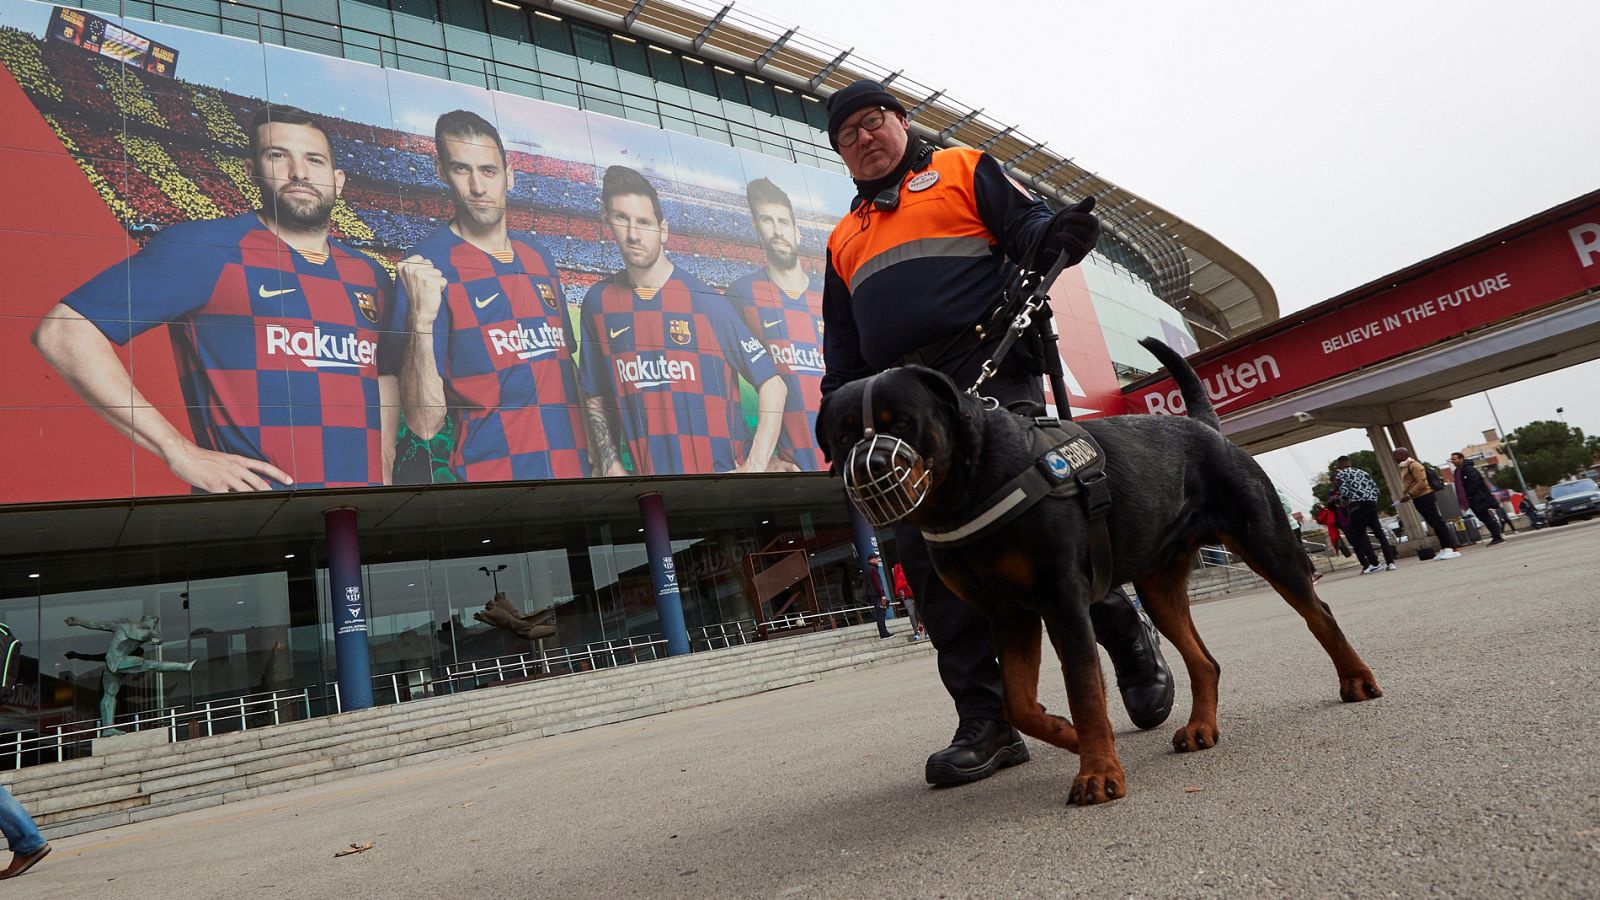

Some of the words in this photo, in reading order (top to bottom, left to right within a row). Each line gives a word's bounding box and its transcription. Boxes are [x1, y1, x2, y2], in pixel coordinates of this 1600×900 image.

[1321, 321, 1382, 354] BELIEVE
[1382, 314, 1402, 332] IN
[1401, 300, 1437, 323] THE
[1437, 272, 1511, 312] FUTURE
[616, 355, 696, 384] Rakuten
[769, 343, 826, 369] Rakut
[1144, 354, 1281, 416] Rauten
